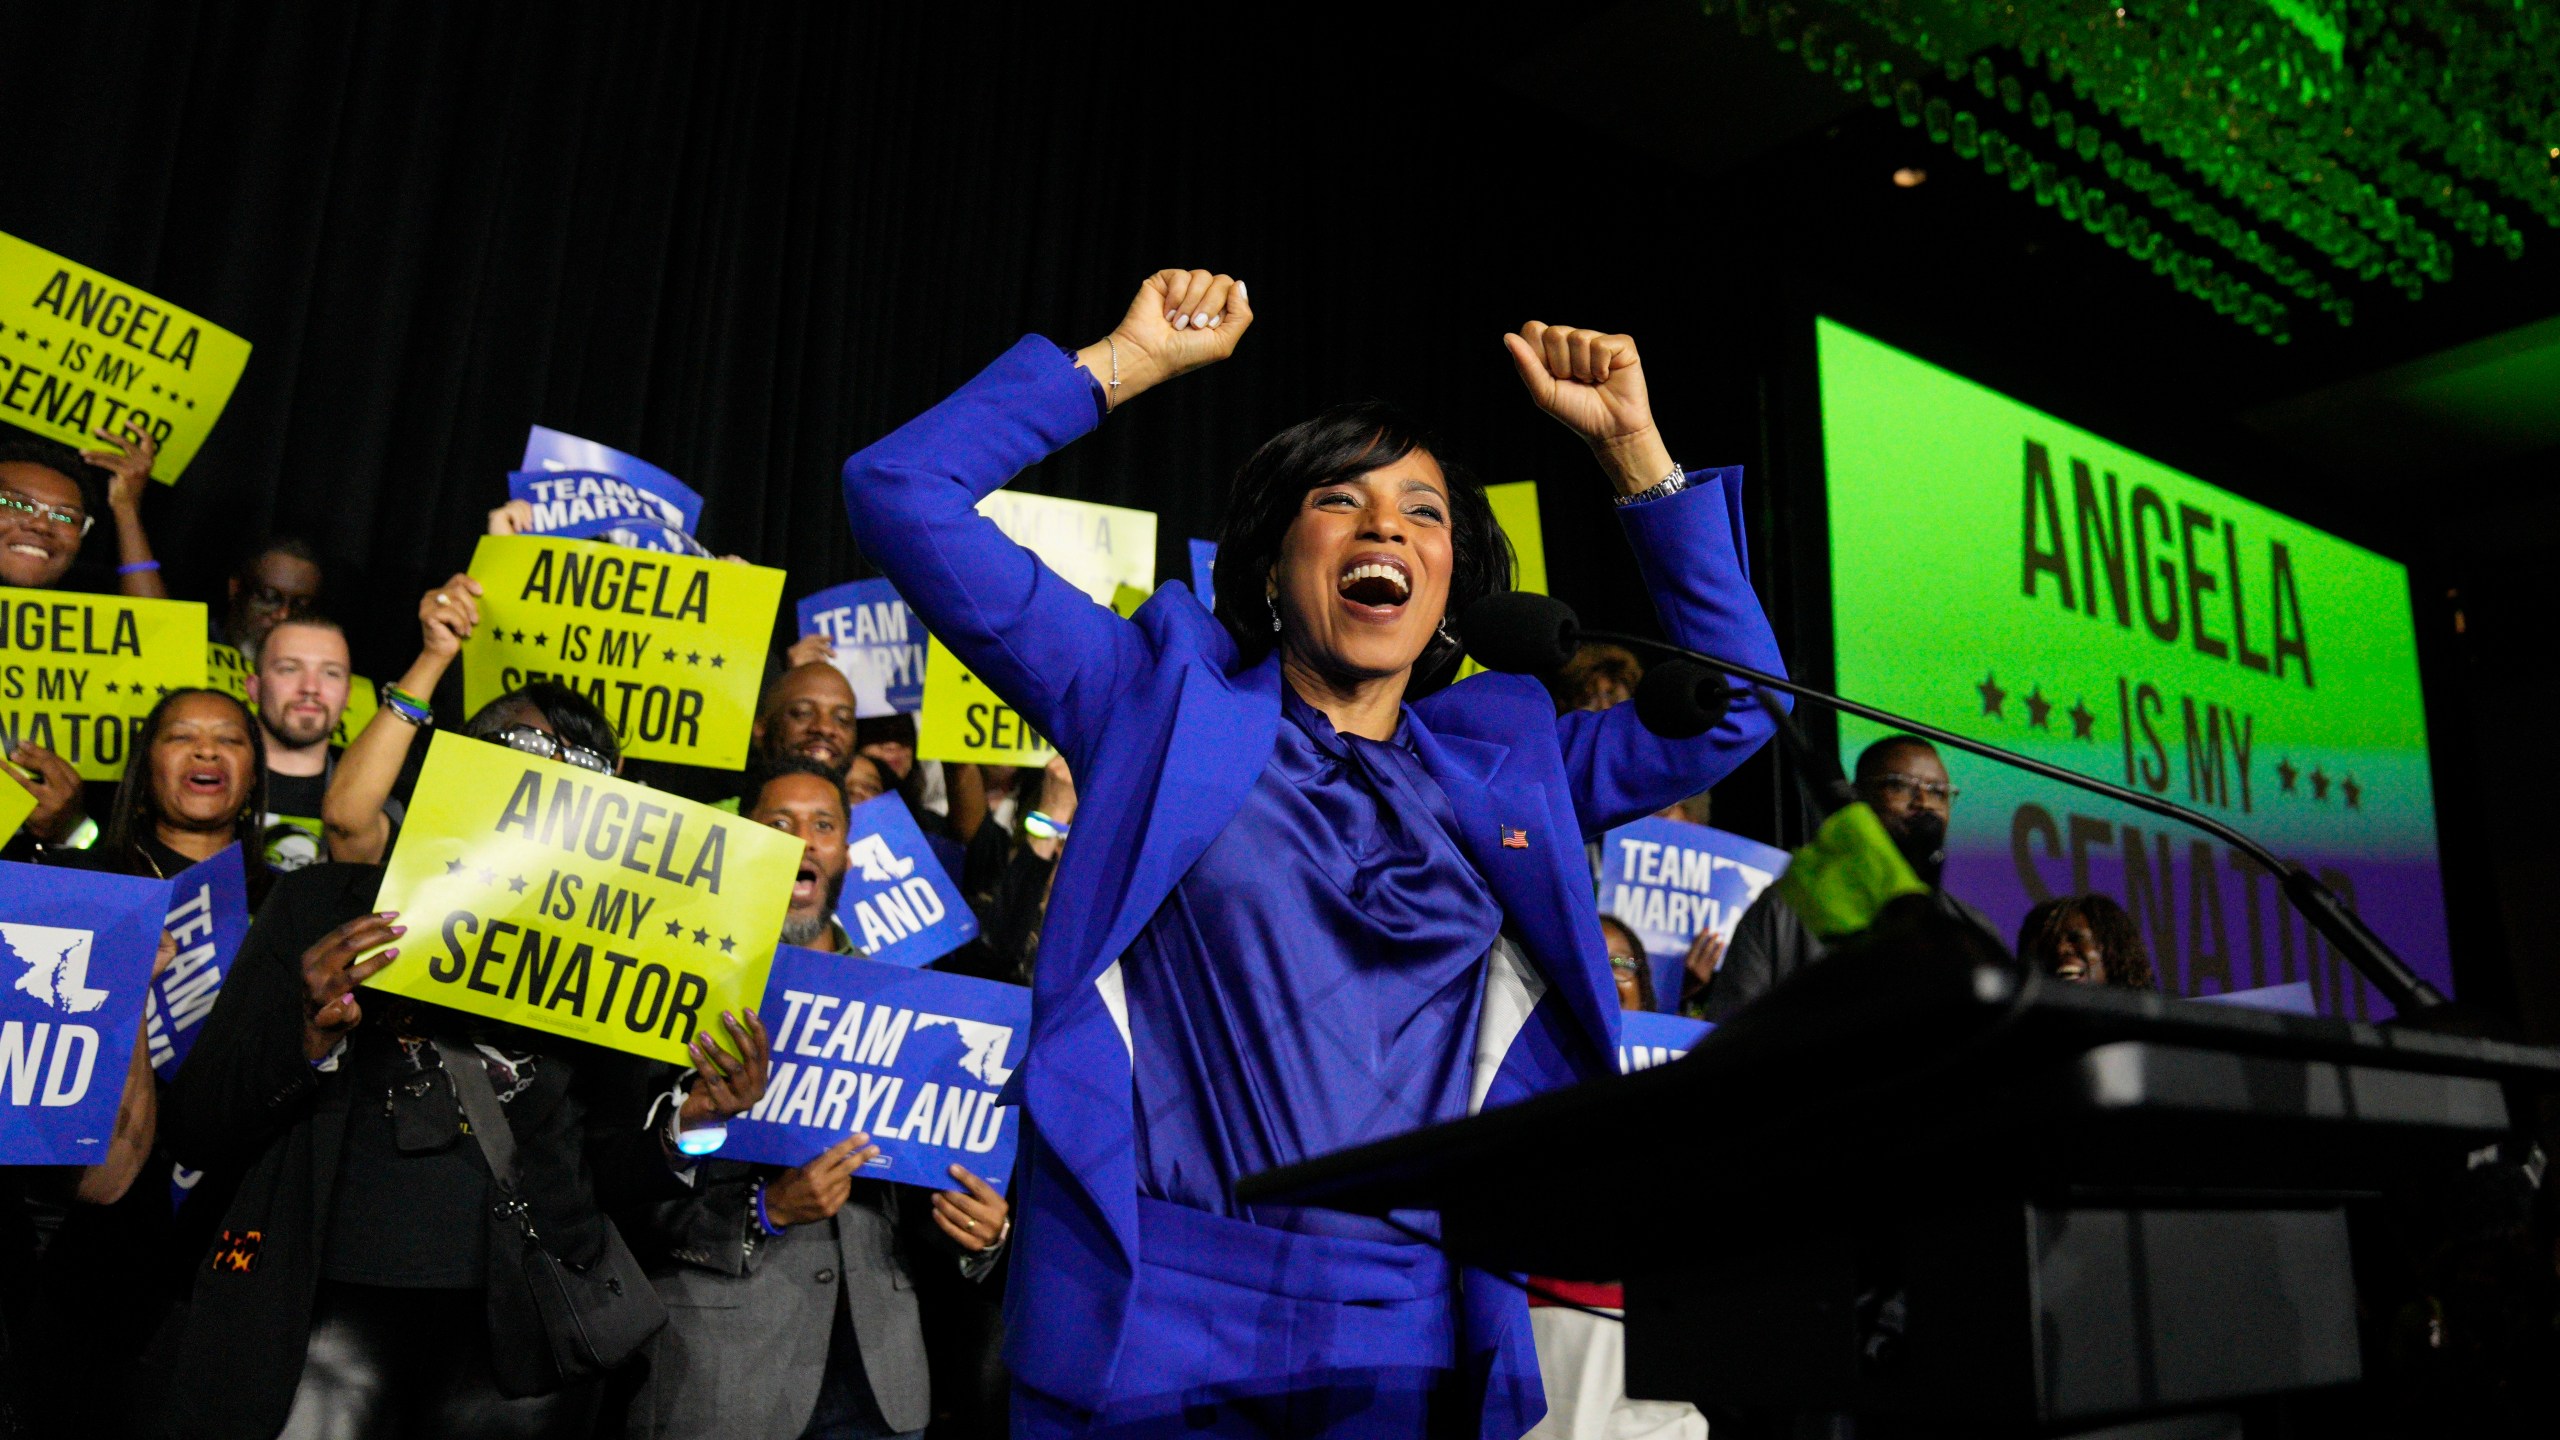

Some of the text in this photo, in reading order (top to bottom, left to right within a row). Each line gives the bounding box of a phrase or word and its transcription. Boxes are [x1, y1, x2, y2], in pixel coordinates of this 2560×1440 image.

[32, 268, 201, 372] ANGELA
[58, 338, 145, 392] IS MY
[529, 477, 637, 502] TEAM
[519, 549, 710, 624] ANGELA
[2022, 437, 2316, 690] ANGELA
[559, 624, 652, 669] IS MY
[812, 600, 908, 646] TEAM
[37, 667, 90, 701] MY
[964, 703, 1056, 751] SEN
[2118, 676, 2253, 815] IS MY
[495, 769, 728, 896] ANGELA
[1619, 838, 1712, 894] TEAM
[539, 870, 656, 941] IS MY
[429, 911, 709, 1046] SENATOR
[773, 989, 914, 1068] TEAM
[737, 1060, 1006, 1153] MARYLAND
